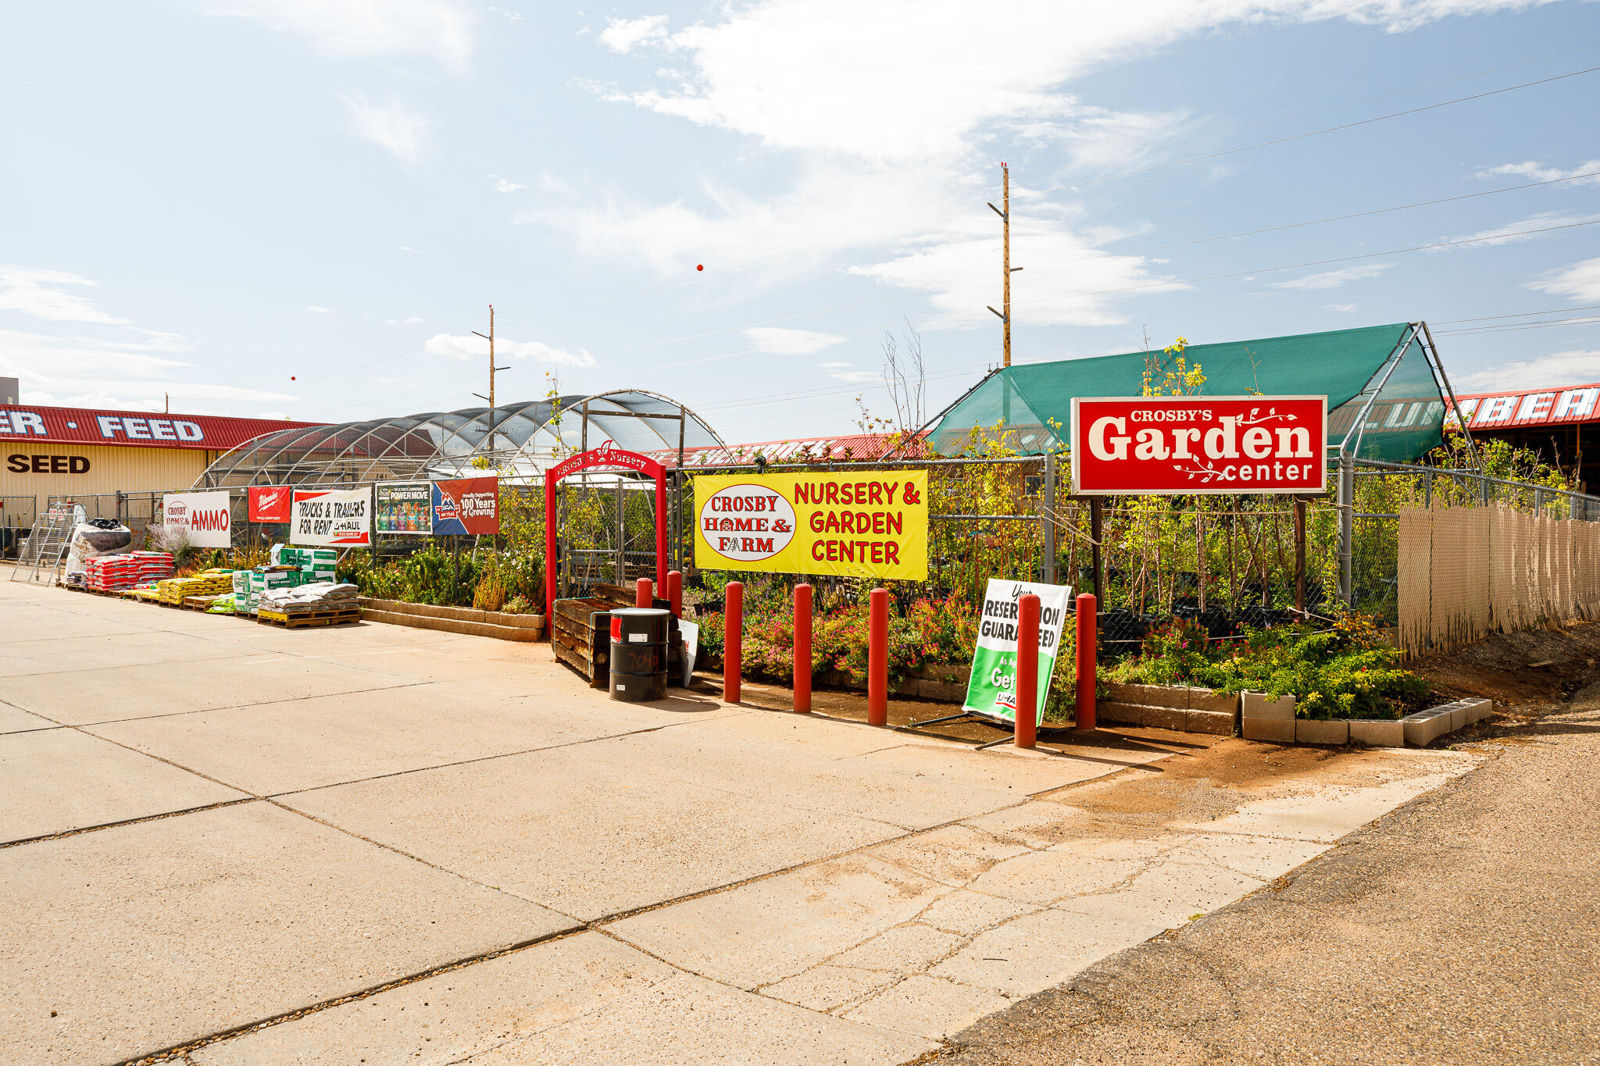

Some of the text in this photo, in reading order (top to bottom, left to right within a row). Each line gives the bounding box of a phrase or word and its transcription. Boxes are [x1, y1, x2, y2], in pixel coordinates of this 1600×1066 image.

[1130, 409, 1213, 422] CROSBY'S
[96, 415, 204, 442] FEED
[1088, 415, 1314, 461] Garden
[7, 454, 91, 474] SEED
[610, 451, 647, 470] Nursery
[1223, 461, 1313, 481] center
[794, 481, 921, 505] NURSERY &
[299, 500, 365, 518] TRUCKS & TRAILERS
[461, 498, 496, 509] 100 Years
[711, 495, 779, 512] CROSBY
[191, 508, 229, 531] AMMO
[469, 508, 495, 519] Growing
[809, 510, 903, 535] GARDEN
[299, 519, 333, 535] FOR RENT
[771, 518, 792, 533] &
[812, 540, 900, 565] CENTER
